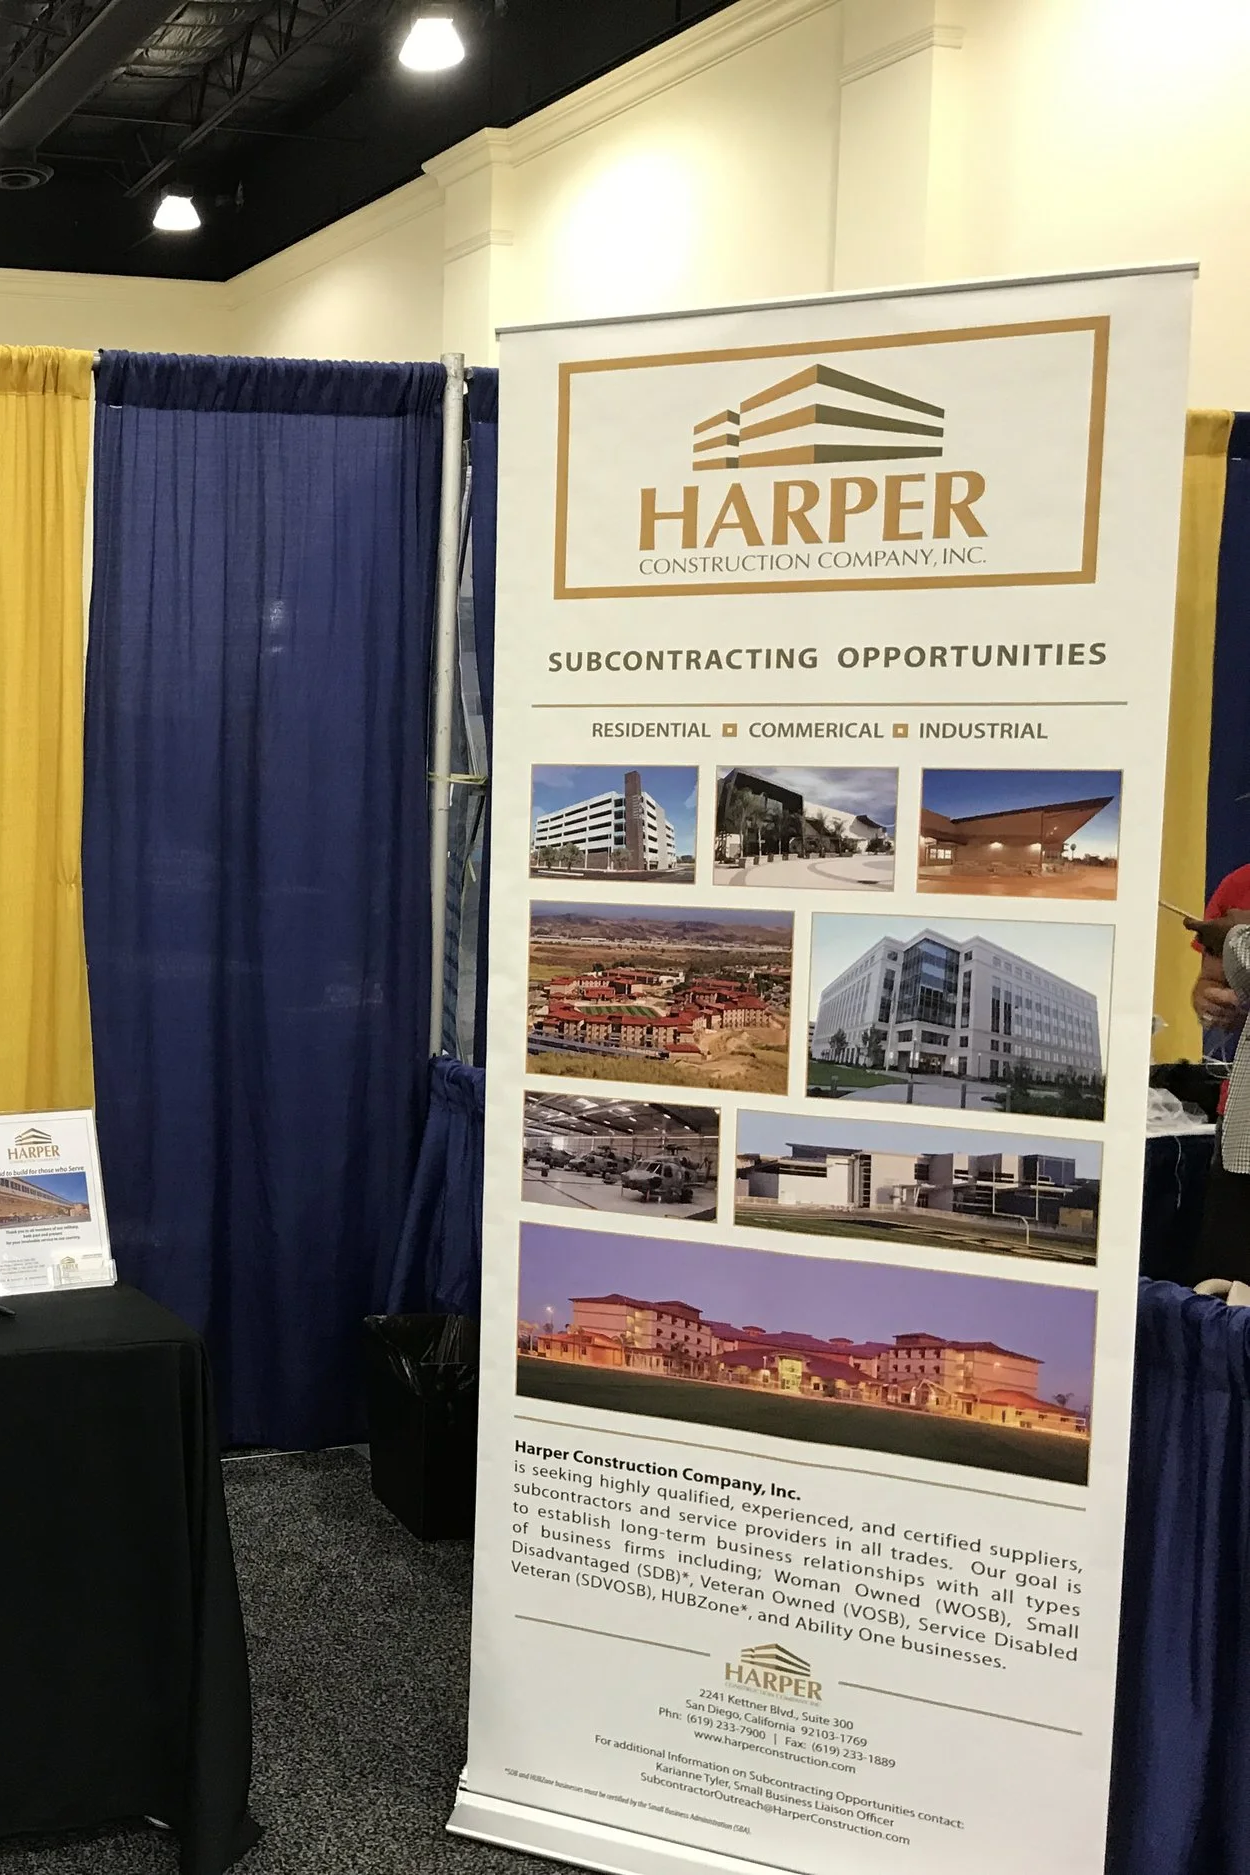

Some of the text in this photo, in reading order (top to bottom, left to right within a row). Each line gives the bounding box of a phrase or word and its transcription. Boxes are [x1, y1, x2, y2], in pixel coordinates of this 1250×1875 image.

[639, 470, 989, 551] HARPER
[639, 546, 987, 576] CONSTRUCTION COMPANY, INC.
[548, 642, 1107, 673] SUBCONTRACTING OPPORTUNITIES
[592, 721, 1048, 741] RESIDENTIAL COMMERICAL INDUSTRIAL
[8, 1144, 60, 1160] HARPER
[514, 1439, 801, 1501] Harper Construction Company, Inc.
[513, 1482, 1082, 1594] subcontractors and service providers in all trades. Our goal is
[514, 1459, 1083, 1574] is seeking highly qualified, experienced, and certified suppliers,
[512, 1501, 1080, 1617] to establish long-term business relationships with all types
[512, 1521, 1079, 1639] of business firms including; Woman Owned (WOSB), Small
[511, 1559, 570, 1583] Veteran
[575, 1571, 656, 1601] (SDVOSB),
[757, 1611, 789, 1627] and
[794, 1616, 853, 1641] Ability
[858, 1627, 895, 1647] One
[901, 1634, 1006, 1670] businesses.
[512, 1539, 629, 1574] Disadvantaged
[700, 1574, 764, 1600] Veteran
[772, 1590, 835, 1614] Owned
[843, 1602, 910, 1630] (VOSB),
[918, 1617, 986, 1643] Service
[994, 1631, 1077, 1662] Disabled
[699, 1688, 724, 1702] 2241
[727, 1694, 772, 1714] Kettner
[770, 1704, 799, 1721] Blvd.,
[801, 1711, 830, 1726] Suite
[832, 1717, 854, 1730] 300
[725, 1662, 822, 1701] HARPER
[658, 1706, 896, 1768] Phn: (619) 233-7900 Fax: (619) 233-1889
[685, 1698, 868, 1747] San Diego, California 92103-1769
[693, 1730, 856, 1774] www.harperconstruction.com
[594, 1734, 964, 1829] For additional Information on Subcontracting Opportunities contact:
[640, 1771, 910, 1845] SubcontractorOutreach@HarperConstruction.com
[655, 1761, 894, 1827] Karianne Tyler, Small Business Liaison Officer
